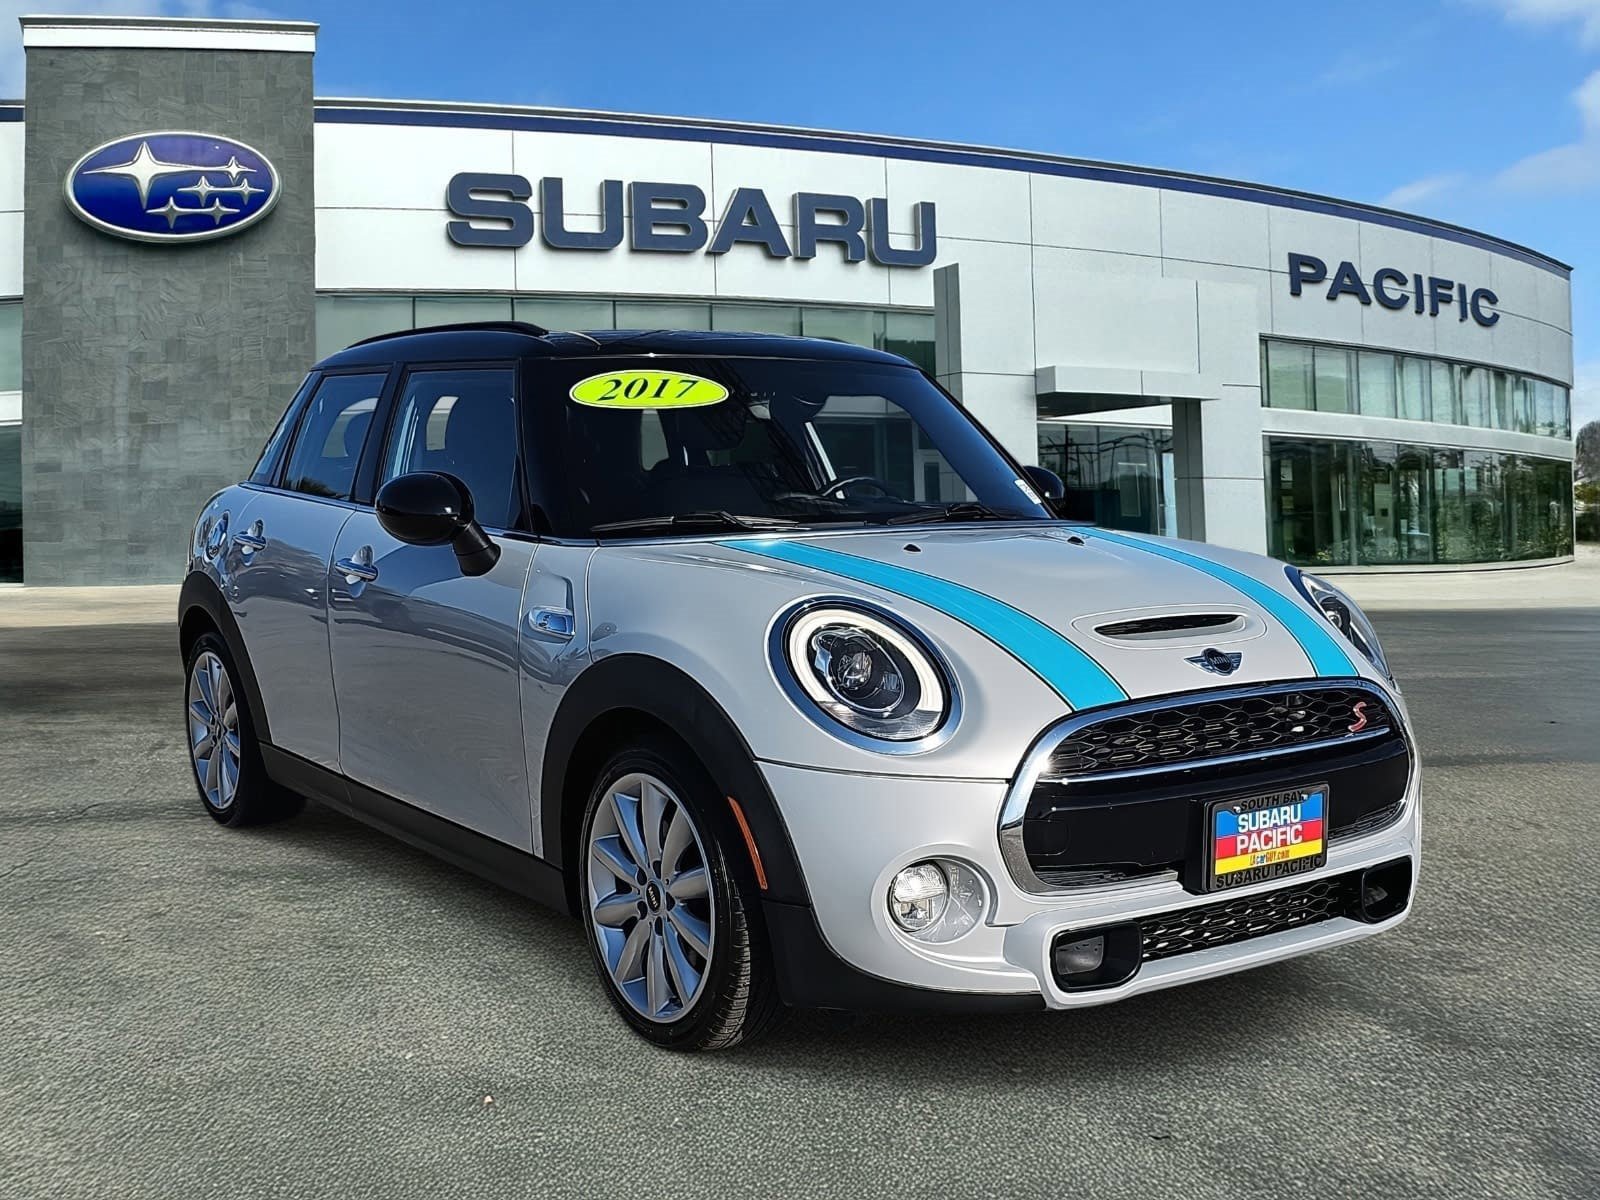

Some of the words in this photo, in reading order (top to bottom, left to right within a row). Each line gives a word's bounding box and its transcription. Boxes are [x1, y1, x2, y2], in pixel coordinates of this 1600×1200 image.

[446, 171, 938, 269] SUBARU
[1288, 252, 1500, 327] PACIFIC
[597, 378, 699, 401] 2017
[1347, 701, 1368, 732] S
[1240, 794, 1280, 811] SOUTH
[1283, 790, 1305, 804] BAY
[1238, 803, 1302, 833] SUBARU
[1236, 824, 1303, 856] PACIFIC
[1215, 865, 1270, 889] SUBARU
[1275, 855, 1322, 876] PACIFIC
